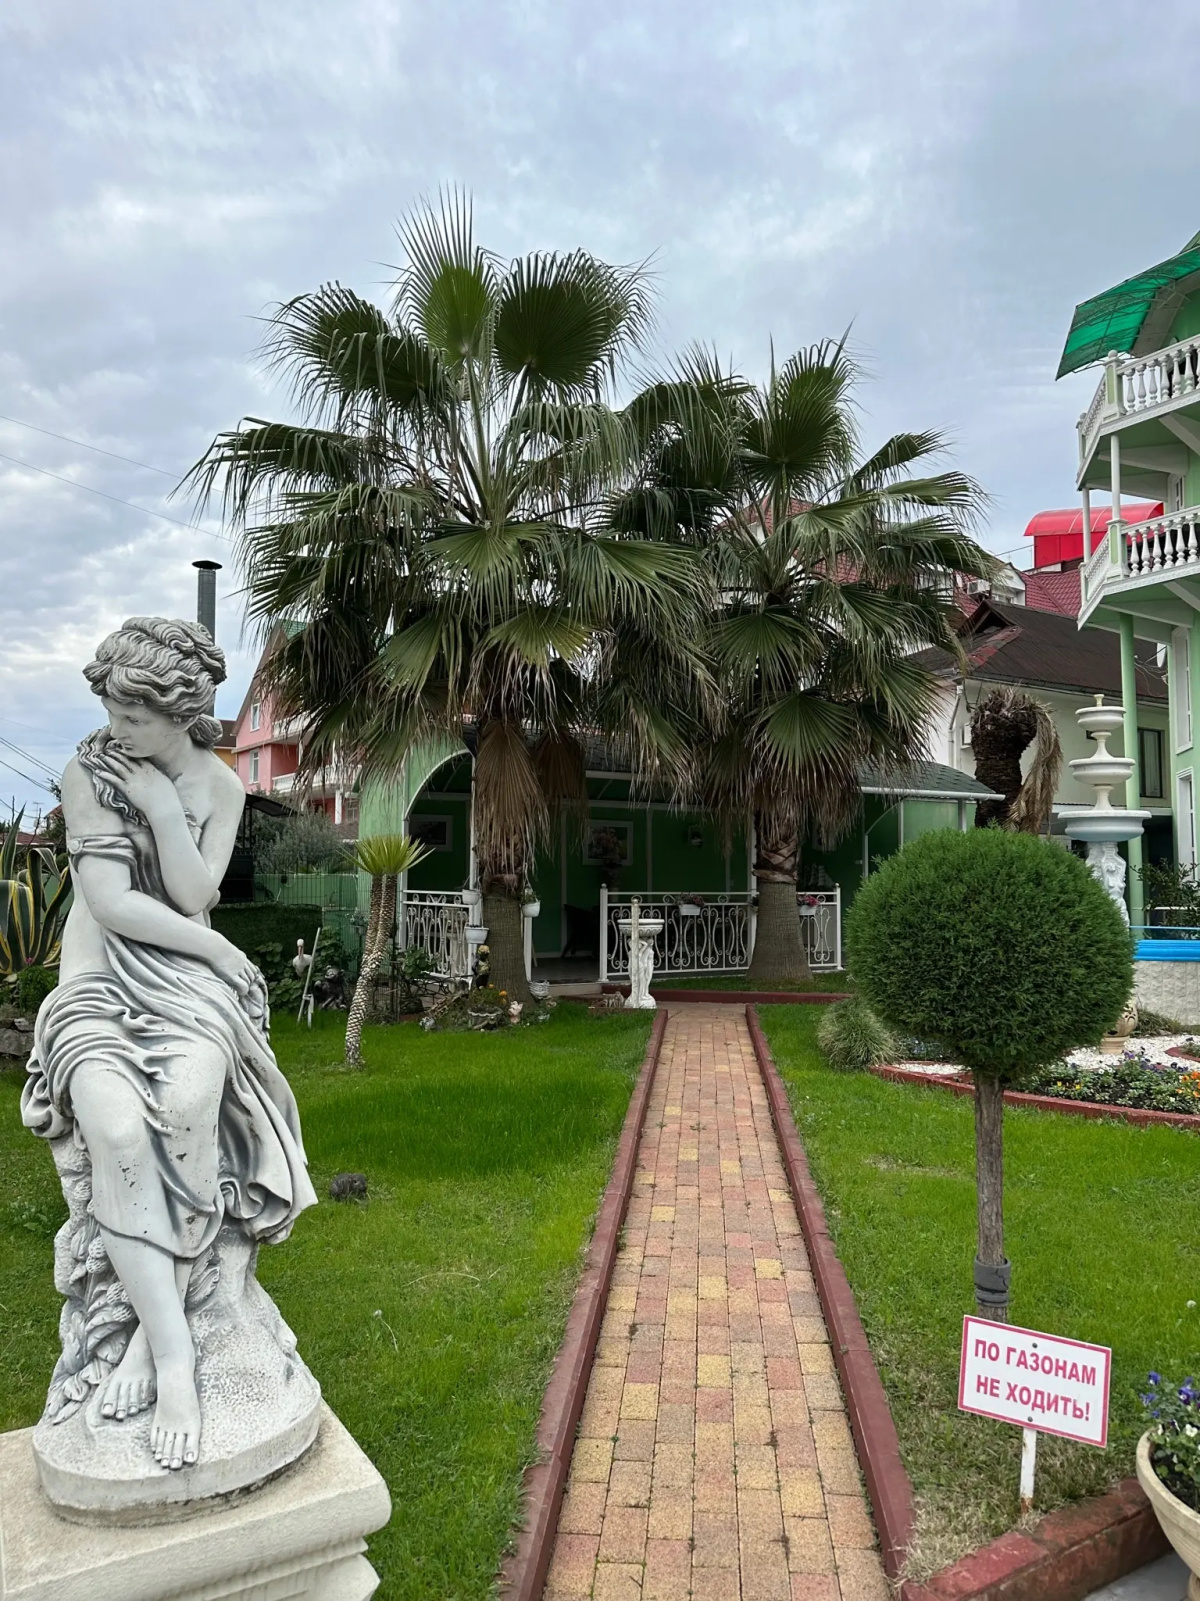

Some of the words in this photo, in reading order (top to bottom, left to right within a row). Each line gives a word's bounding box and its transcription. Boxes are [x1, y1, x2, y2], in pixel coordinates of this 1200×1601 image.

[974, 1339, 1000, 1361] ПО
[1006, 1346, 1096, 1386] ГАЗОНАМ
[976, 1374, 1000, 1398] НЕ
[1006, 1382, 1090, 1421] ХОДИТЬ!
